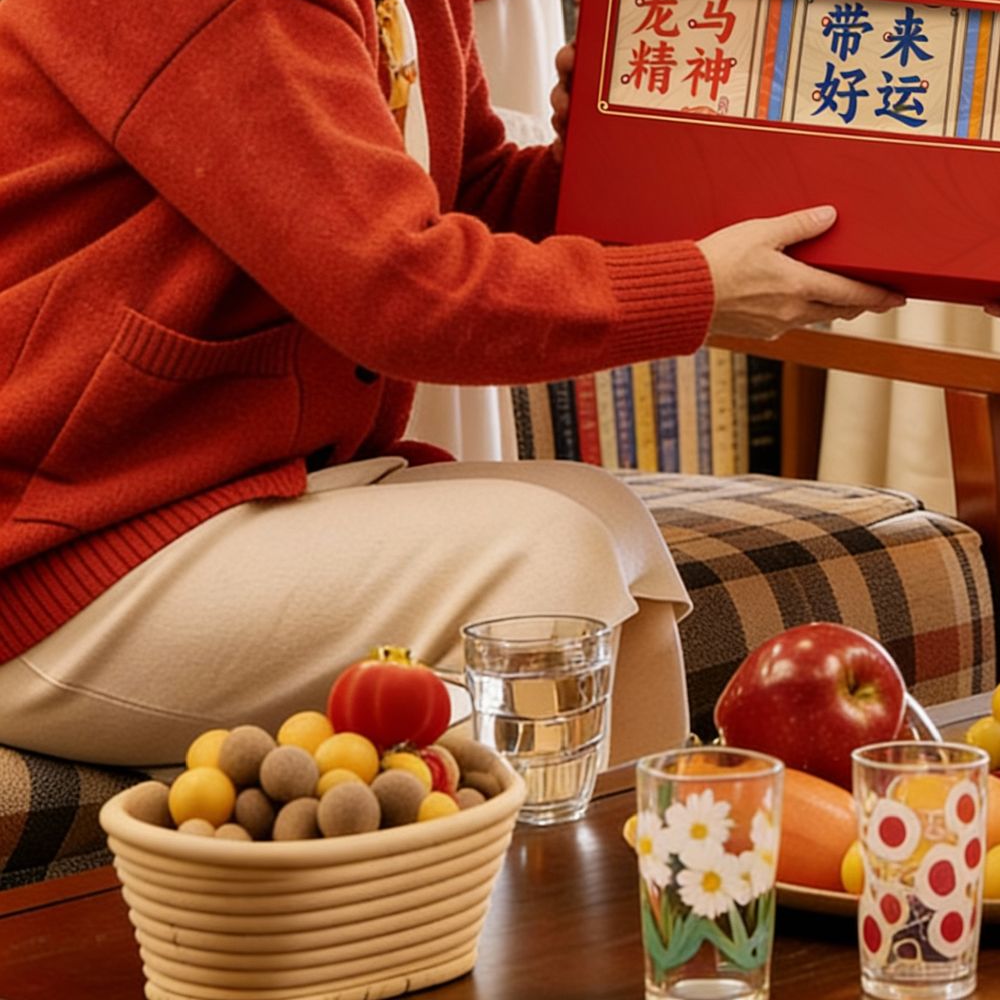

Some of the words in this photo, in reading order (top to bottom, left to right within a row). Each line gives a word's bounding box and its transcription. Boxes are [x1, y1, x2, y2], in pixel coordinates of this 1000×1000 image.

[821, 2, 935, 67] 带来
[625, 39, 737, 101] 精神
[810, 61, 930, 127] 好运
